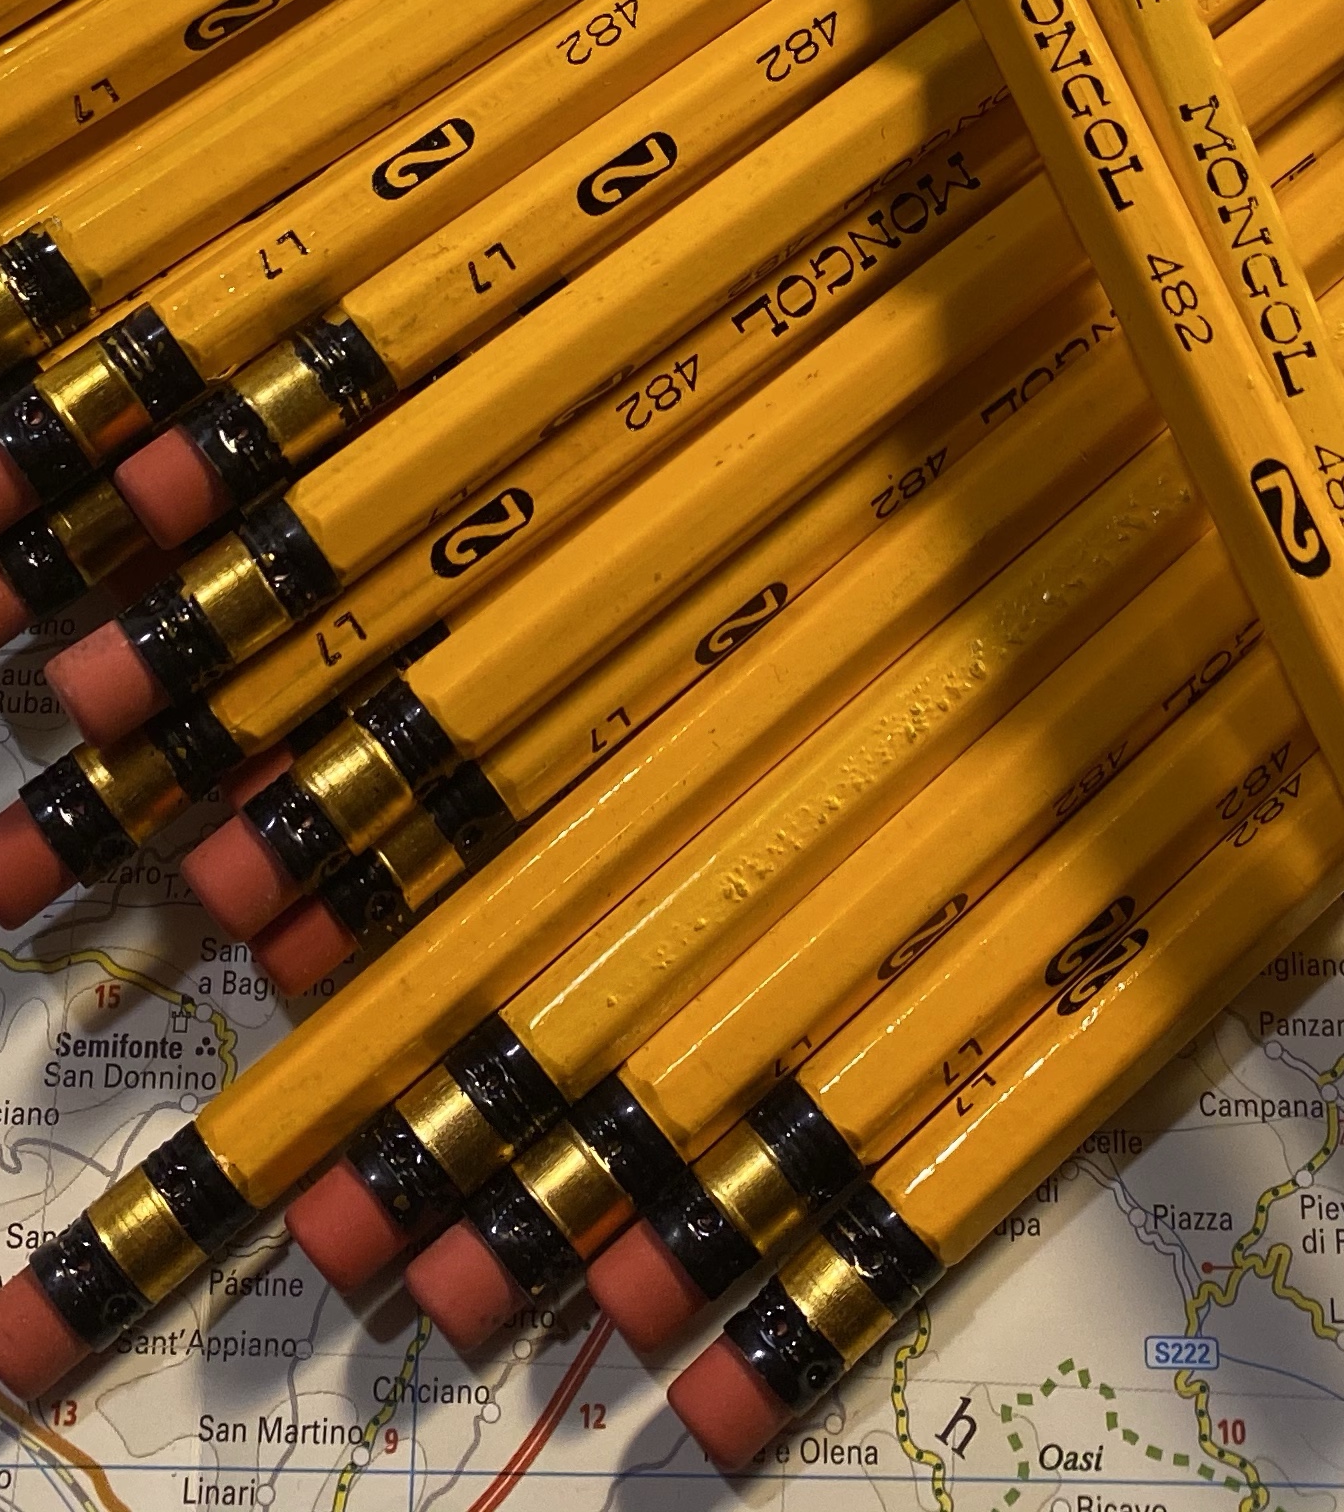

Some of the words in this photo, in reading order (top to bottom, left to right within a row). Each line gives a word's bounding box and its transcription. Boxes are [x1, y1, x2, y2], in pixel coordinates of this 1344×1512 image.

[756, 11, 838, 84] 482
[74, 77, 120, 126] L7
[259, 230, 312, 279] L7
[467, 242, 517, 294] L7
[732, 154, 981, 338] MONGOL
[1180, 96, 1317, 396] MONGOL
[1145, 253, 1212, 352] 482
[615, 354, 701, 430] 482
[316, 612, 367, 667] L7
[57, 1034, 183, 1060] Semifonte
[1155, 1342, 1210, 1364] S222
[1039, 1444, 1103, 1472] Oasi
[184, 1480, 255, 1506] Linari
